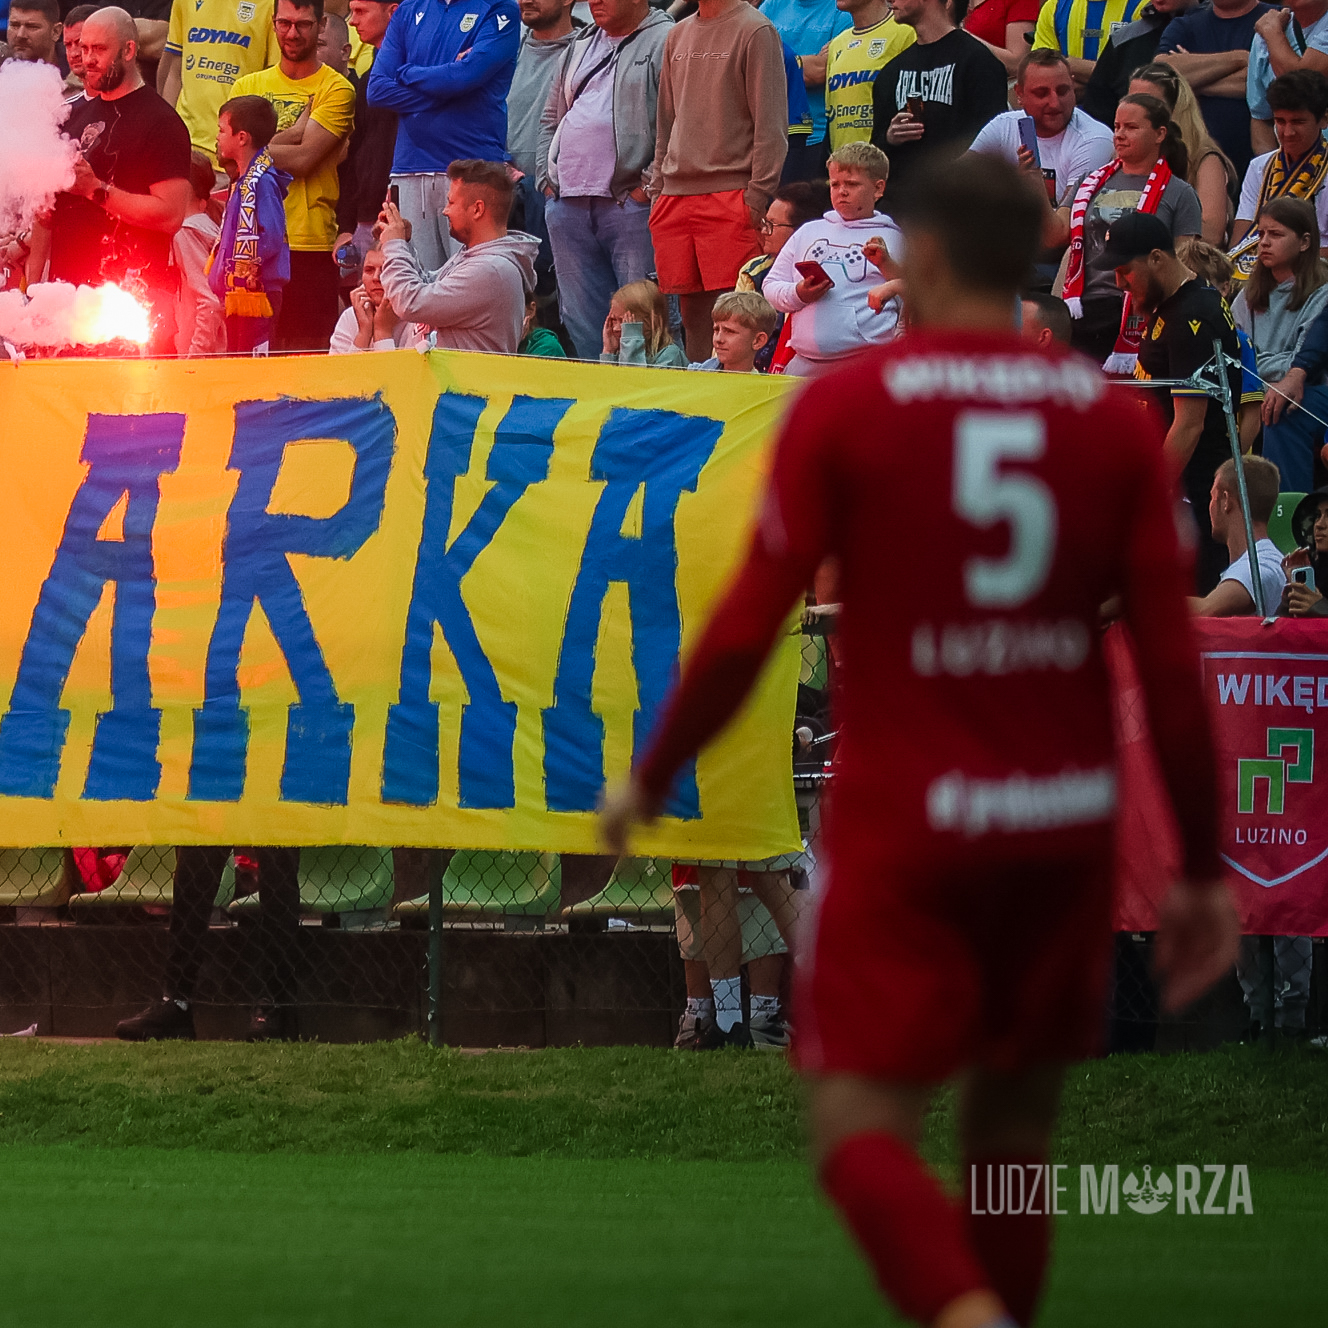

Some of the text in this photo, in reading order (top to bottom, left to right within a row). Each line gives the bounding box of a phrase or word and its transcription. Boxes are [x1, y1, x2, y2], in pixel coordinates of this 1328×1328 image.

[188, 27, 251, 49] GDYNIA
[198, 57, 240, 75] Energa
[952, 407, 1060, 610] 5
[1276, 504, 1284, 518] 5
[1235, 827, 1307, 845] LUZINO
